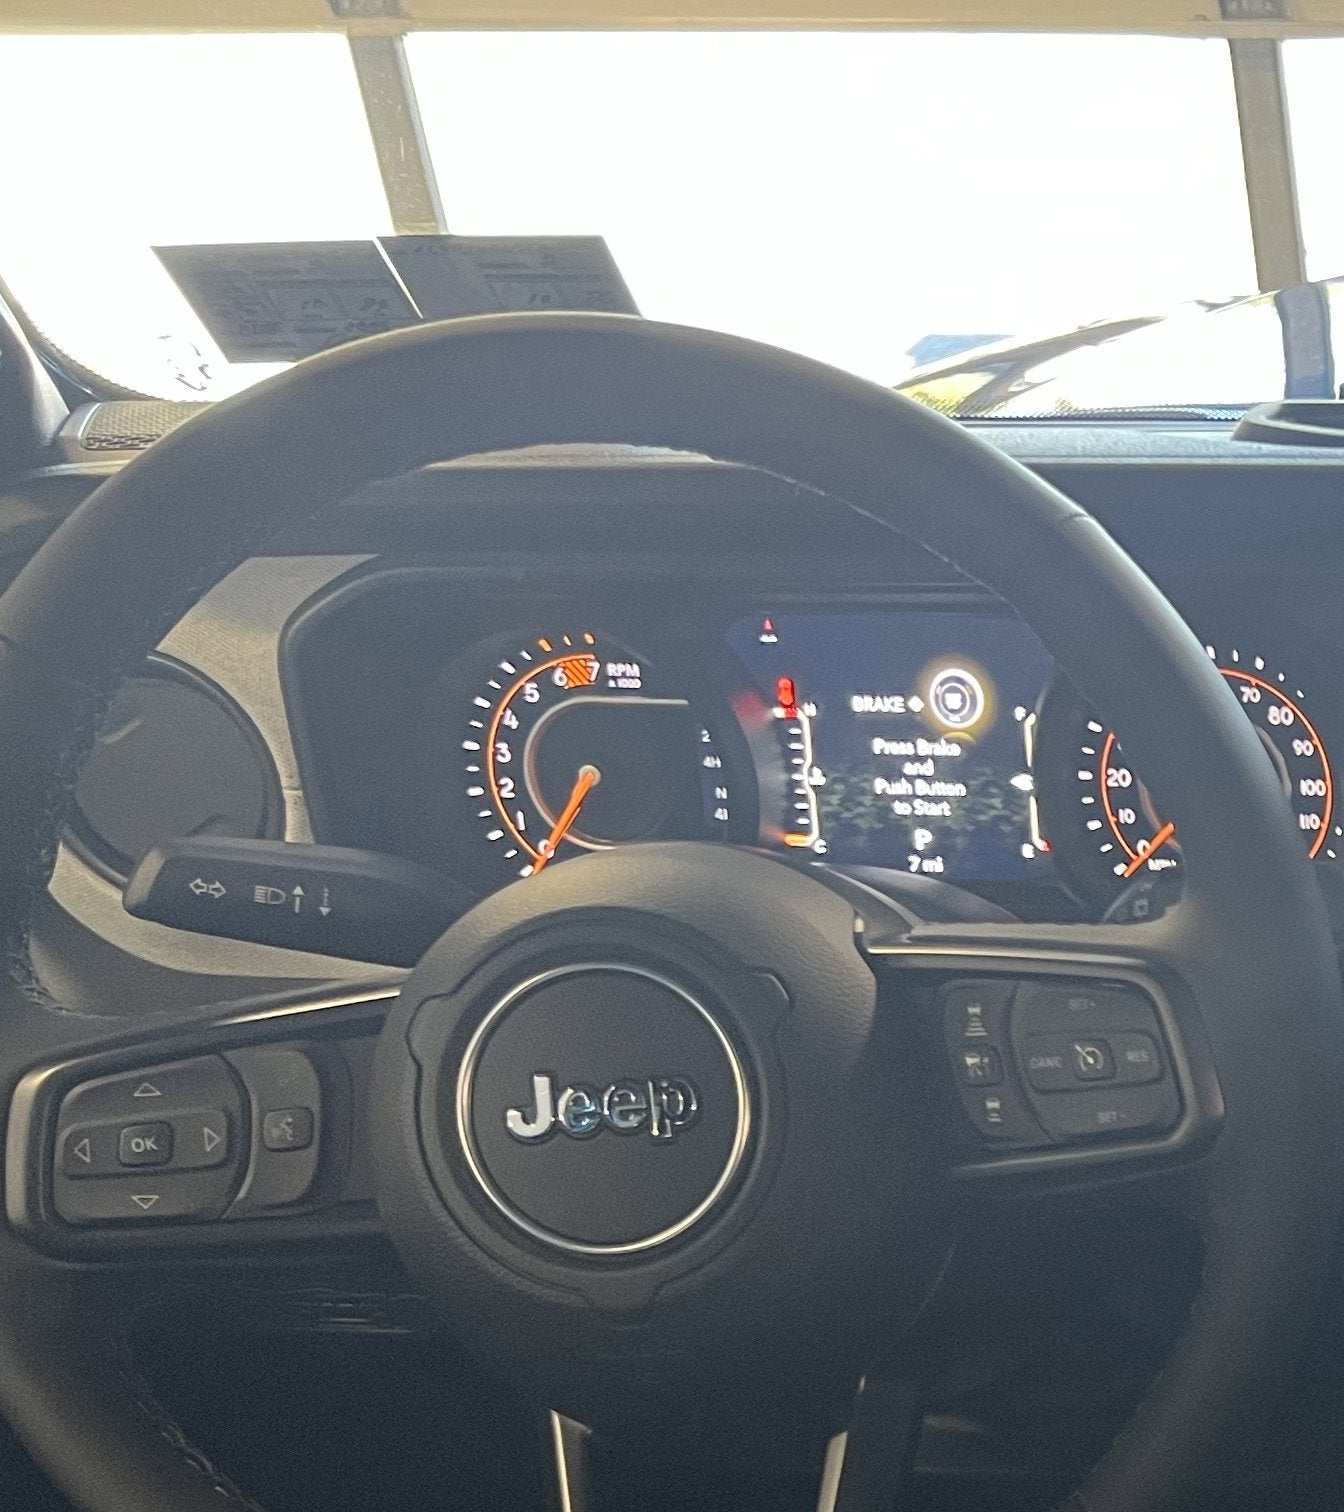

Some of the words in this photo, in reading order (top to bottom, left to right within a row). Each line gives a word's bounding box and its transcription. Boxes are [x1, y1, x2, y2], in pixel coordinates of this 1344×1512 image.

[553, 667, 569, 687] 6
[586, 660, 600, 682] 7
[606, 662, 641, 678] RPM
[522, 682, 540, 703] 5
[1240, 686, 1261, 703] 70
[851, 695, 906, 713] BRAKE
[503, 707, 520, 730] 4
[1266, 705, 1294, 726] 80
[495, 742, 512, 763] 3
[872, 737, 915, 756] Press
[916, 737, 961, 757] Brake
[1292, 739, 1314, 756] 90
[902, 757, 935, 777] and
[497, 777, 515, 799] 2
[874, 777, 913, 796] Push
[914, 778, 967, 797] Button
[1106, 768, 1132, 788] 20
[1300, 779, 1326, 796] 100
[893, 799, 912, 816] to
[913, 798, 952, 817] Start
[1118, 808, 1136, 825] 10
[515, 810, 526, 831] 1
[1299, 813, 1321, 830] 110
[913, 828, 934, 851] P
[908, 854, 921, 873] 7
[922, 855, 944, 873] mi
[506, 1073, 697, 1139] Jeep
[130, 1136, 157, 1153] OK
